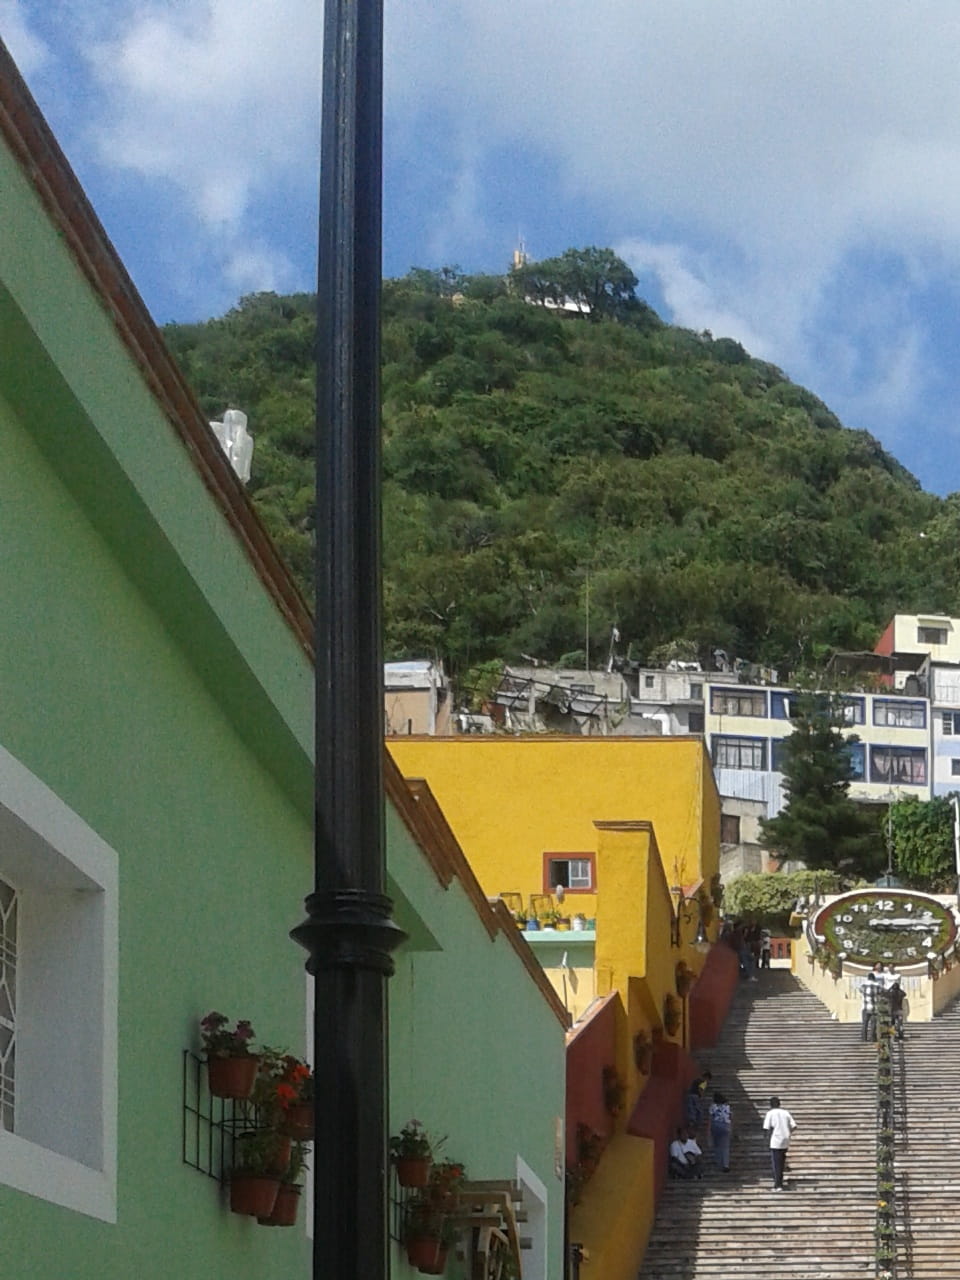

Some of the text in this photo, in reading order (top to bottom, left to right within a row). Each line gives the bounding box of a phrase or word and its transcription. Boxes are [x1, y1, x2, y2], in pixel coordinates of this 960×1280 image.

[851, 904, 868, 913] 11
[875, 900, 894, 910] 12
[904, 903, 912, 912] 1
[834, 915, 853, 923] 10
[835, 927, 844, 935] 9
[843, 940, 853, 949] 8
[921, 937, 932, 947] 4
[907, 947, 916, 956] 5
